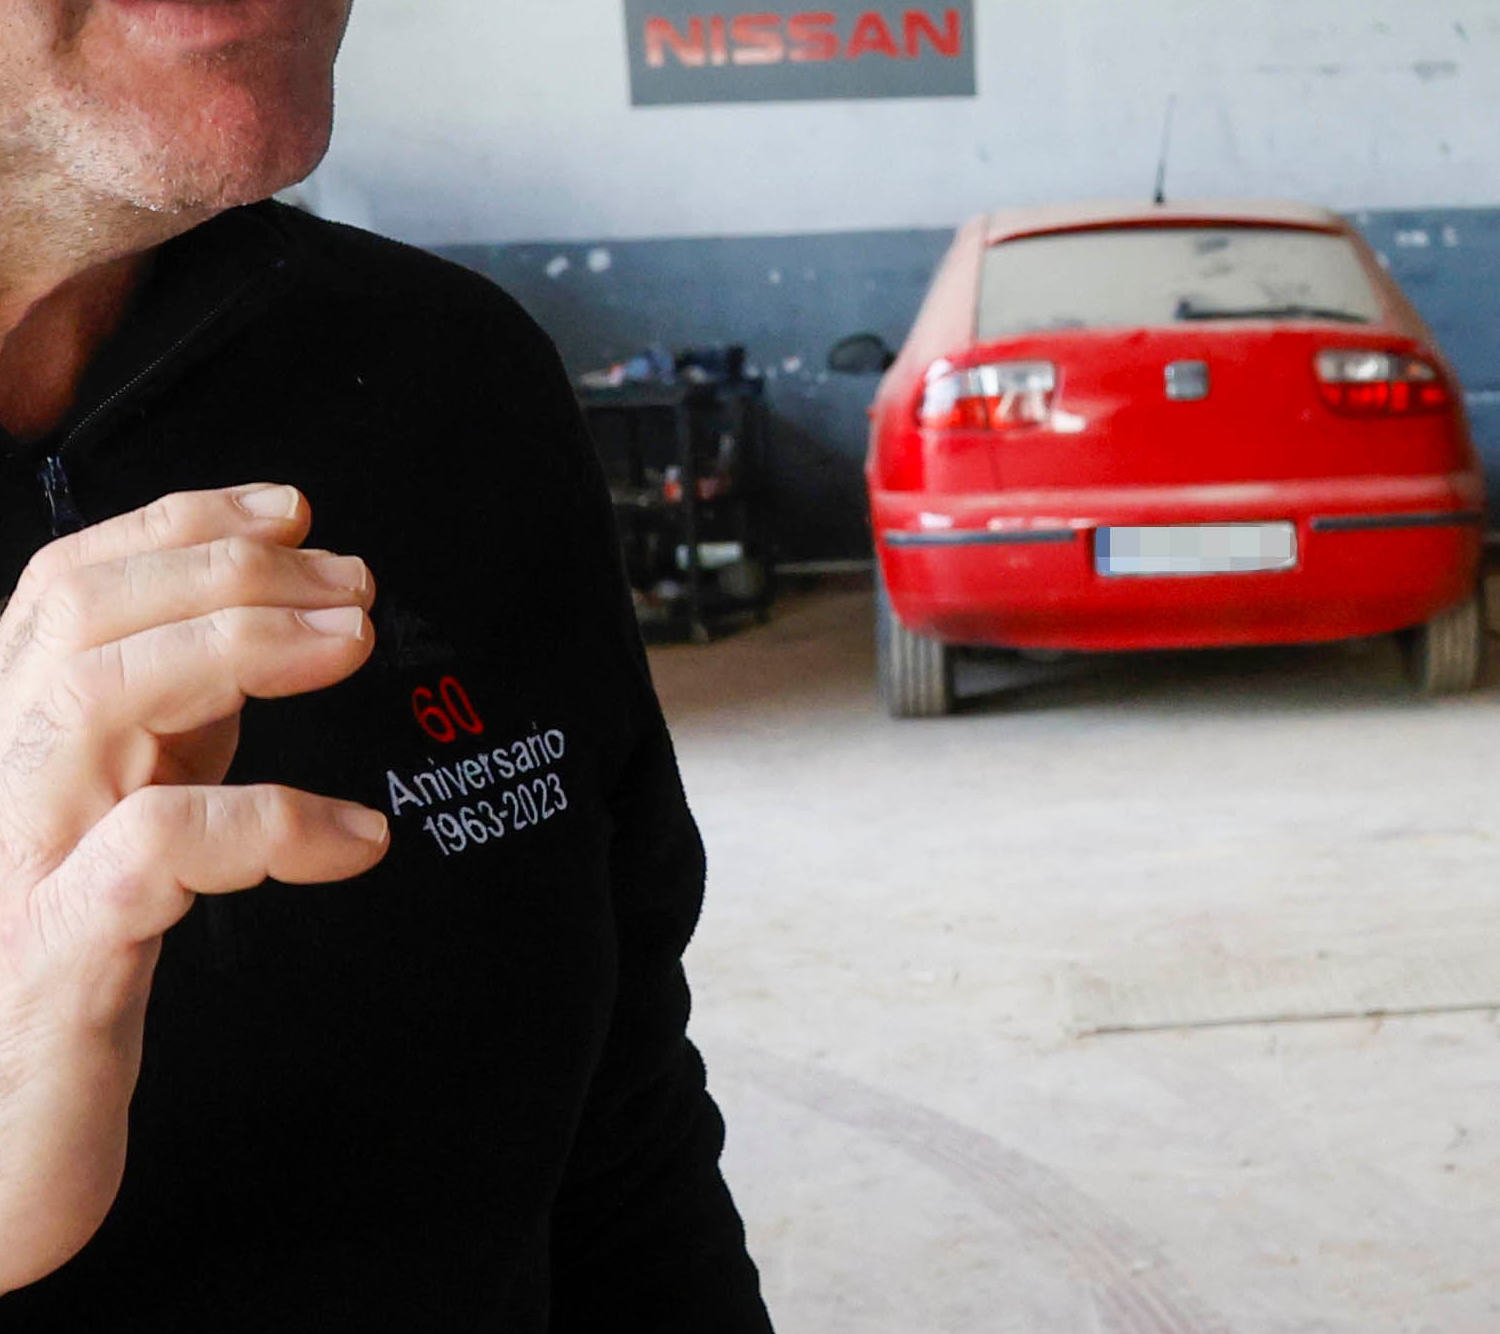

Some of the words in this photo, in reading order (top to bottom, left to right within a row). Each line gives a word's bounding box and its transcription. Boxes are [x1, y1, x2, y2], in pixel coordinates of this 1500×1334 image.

[644, 9, 962, 68] NISSAN
[412, 676, 484, 743] 60
[386, 721, 565, 816] Aniversario
[422, 773, 568, 856] 1963-2023
